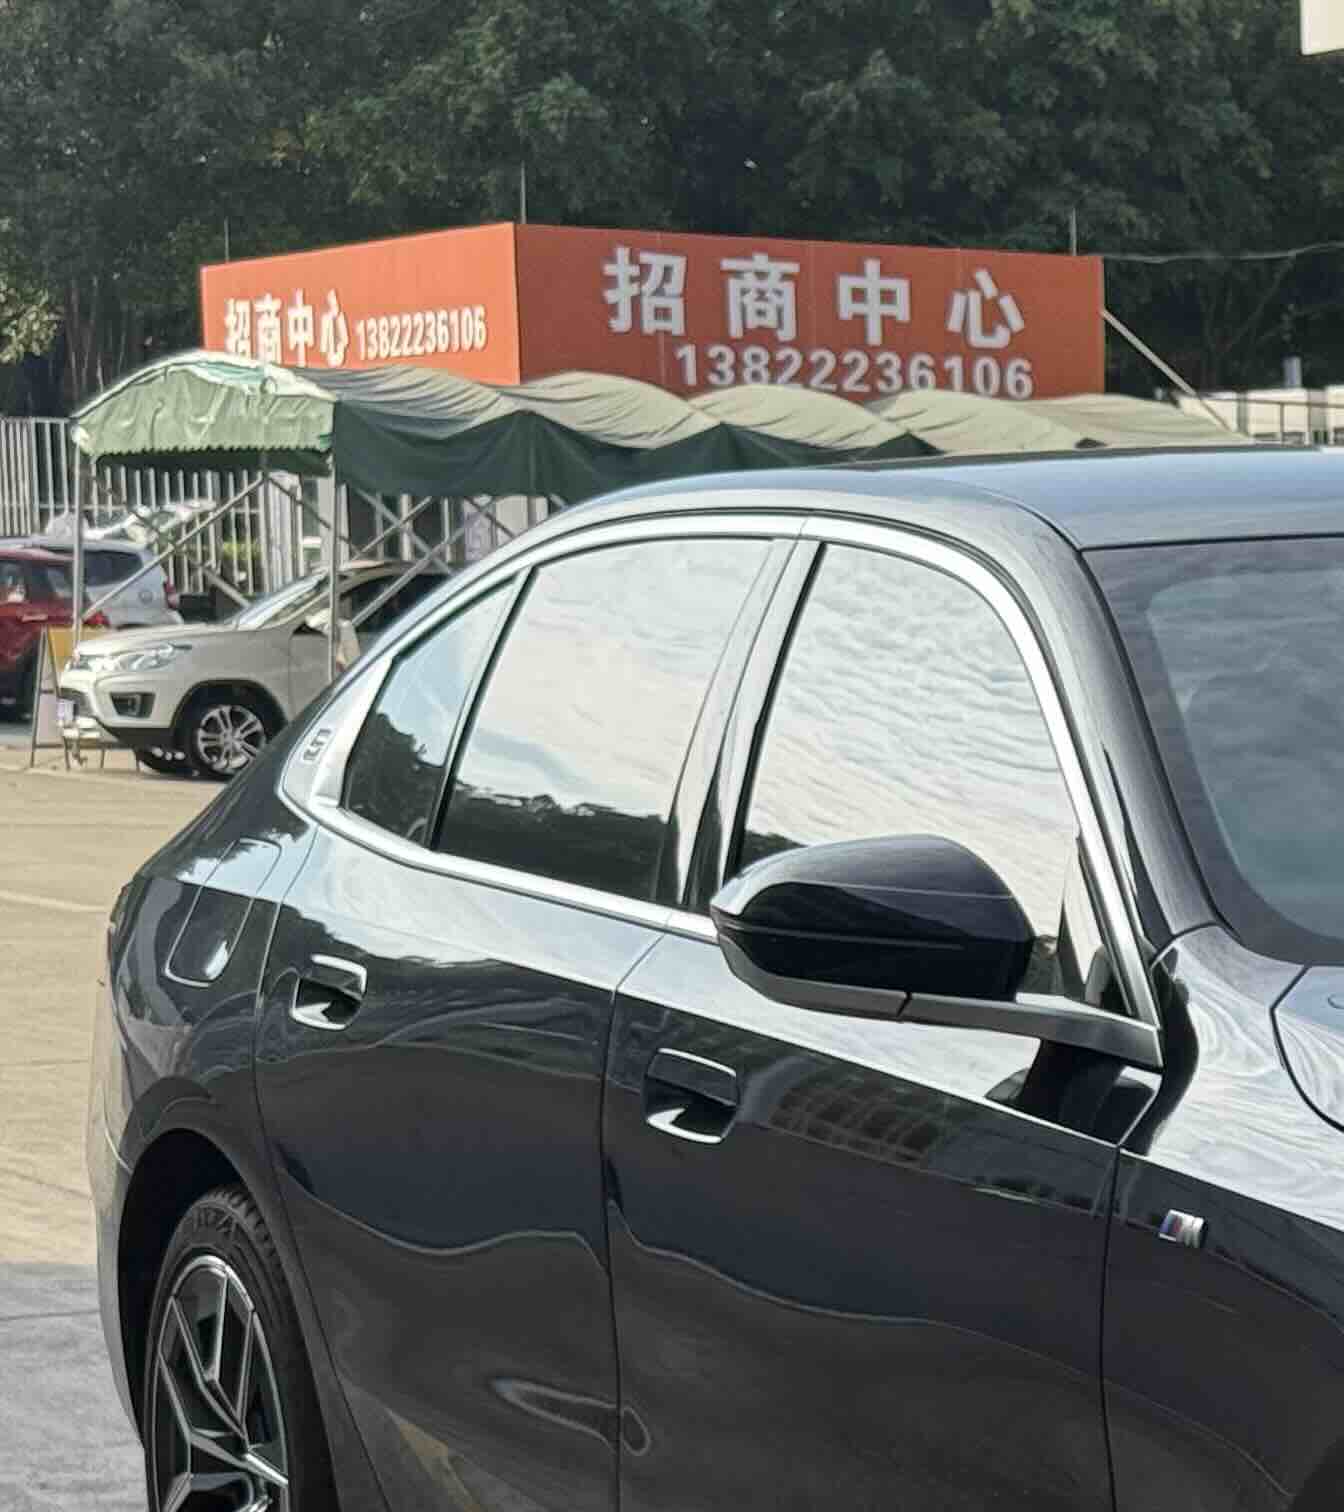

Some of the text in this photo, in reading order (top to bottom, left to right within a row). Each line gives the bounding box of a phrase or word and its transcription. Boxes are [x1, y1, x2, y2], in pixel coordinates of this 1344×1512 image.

[224, 288, 349, 366] 招商中心
[604, 247, 1025, 349] 招商中心
[355, 304, 487, 361] 13822236106
[675, 344, 1034, 399] 13822236106
